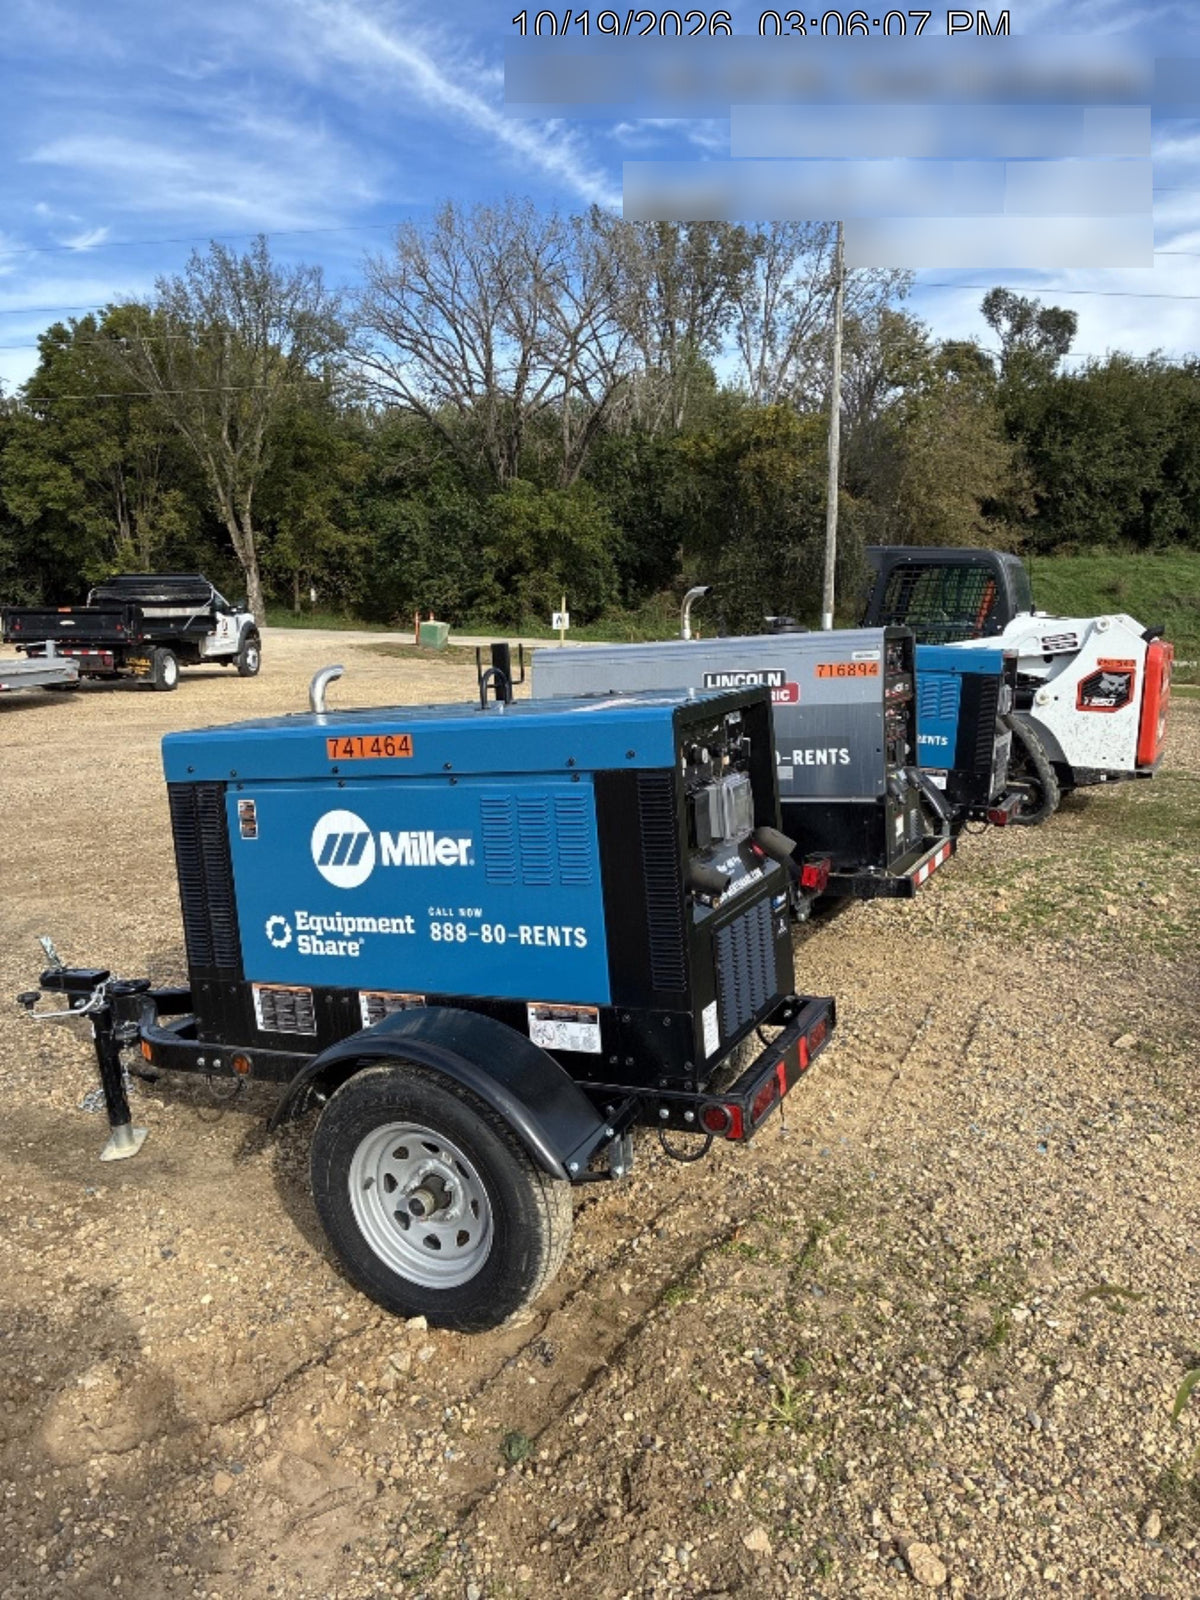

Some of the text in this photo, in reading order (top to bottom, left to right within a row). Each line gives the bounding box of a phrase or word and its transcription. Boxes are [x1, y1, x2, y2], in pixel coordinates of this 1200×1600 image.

[706, 671, 782, 689] LINCOLN
[817, 665, 879, 677] 716894
[329, 736, 410, 757] 741464
[428, 906, 483, 918] CALL NOW
[294, 910, 415, 936] Equipment
[297, 934, 364, 957] Share
[429, 922, 588, 948] 888-80-RENTS
